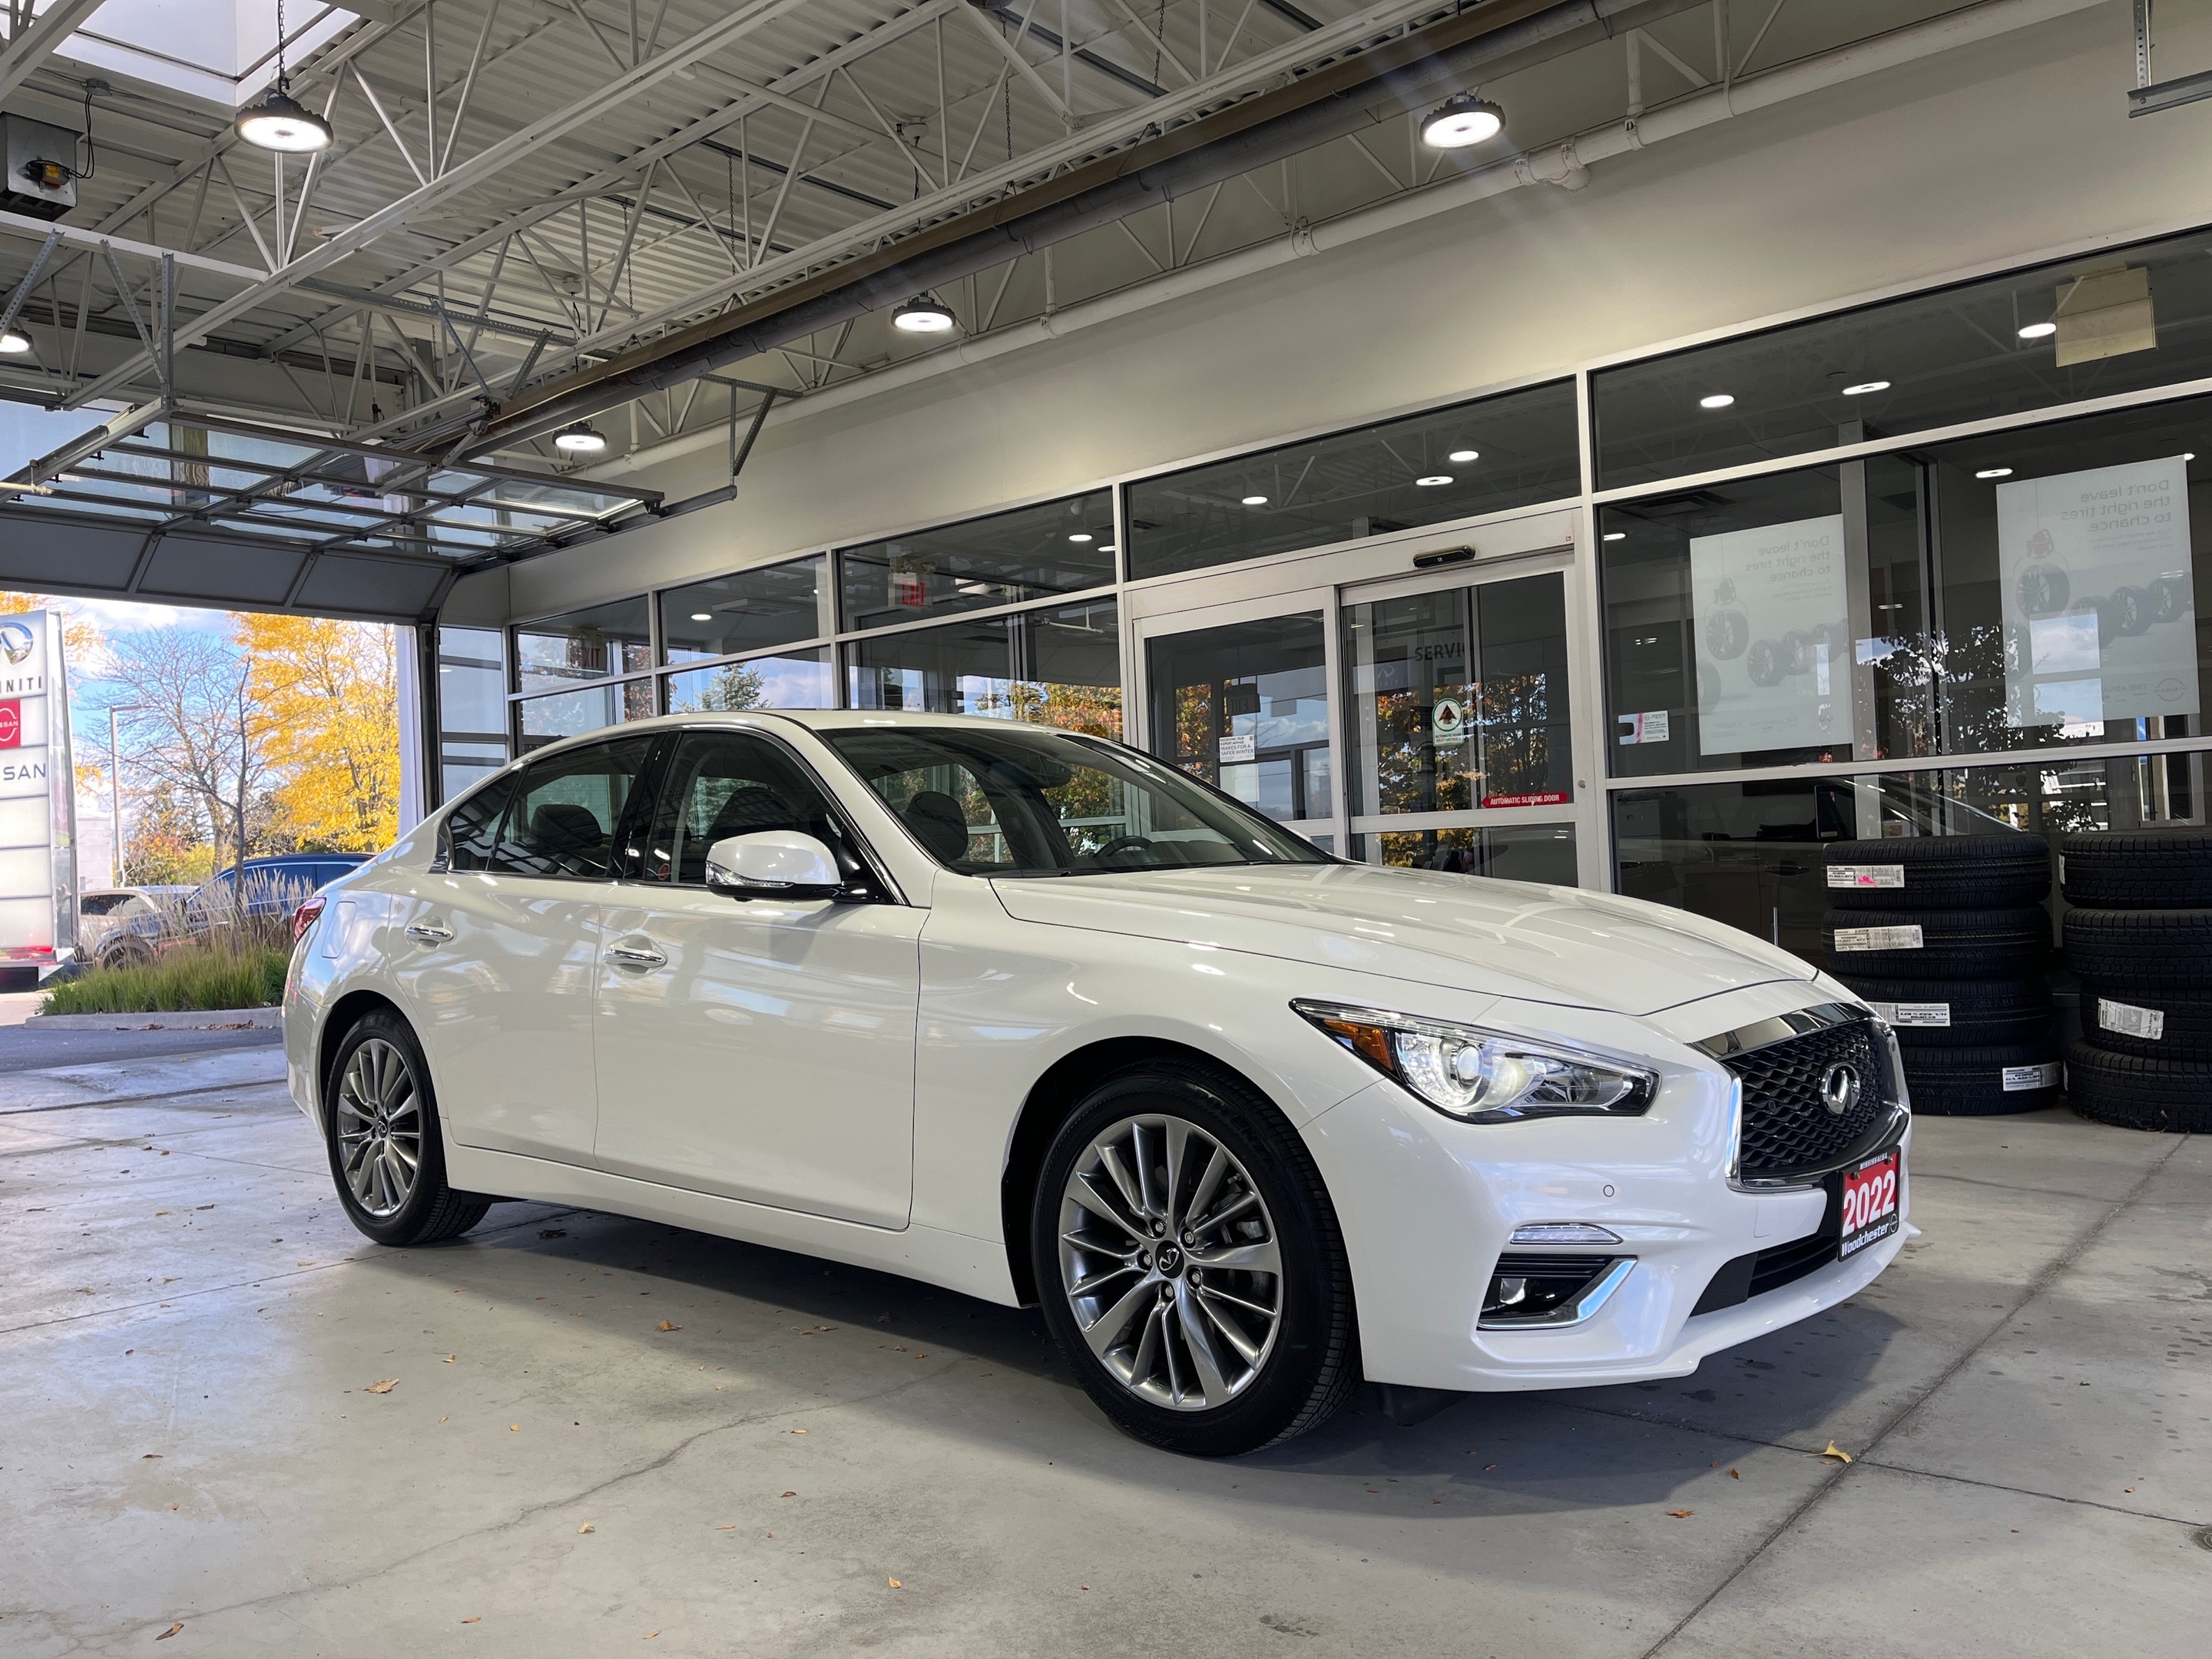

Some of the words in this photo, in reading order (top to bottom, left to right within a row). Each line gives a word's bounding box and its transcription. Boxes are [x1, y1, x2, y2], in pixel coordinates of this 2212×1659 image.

[902, 581, 926, 606] EXIT
[1414, 641, 1465, 662] SERVI
[3, 763, 46, 780] SAN
[1842, 1170, 1896, 1238] 2022
[1841, 1222, 1889, 1257] Woodchester
